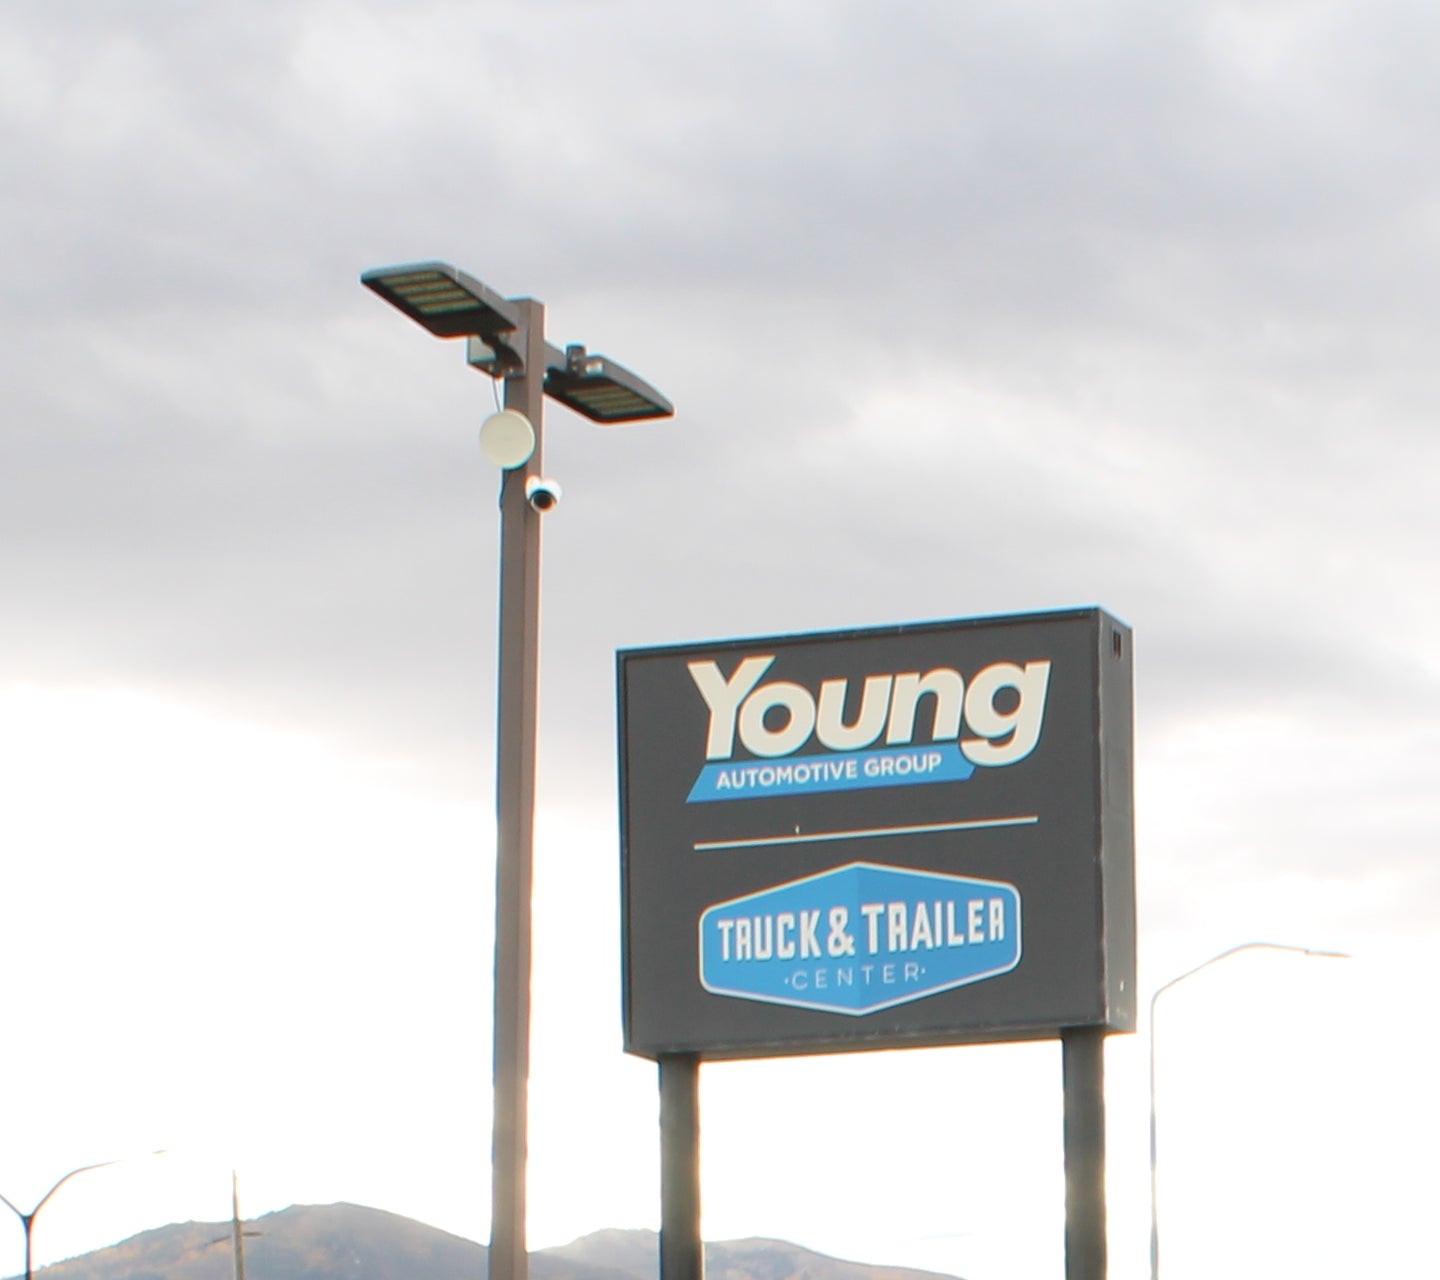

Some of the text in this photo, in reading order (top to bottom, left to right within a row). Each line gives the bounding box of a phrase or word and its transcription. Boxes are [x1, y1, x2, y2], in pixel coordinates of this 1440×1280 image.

[687, 655, 1051, 767] Young
[715, 753, 942, 790] AUTOMOTIVE GROUP
[718, 898, 1005, 961] TRUCK & TRAILER
[791, 962, 920, 990] CENTER
